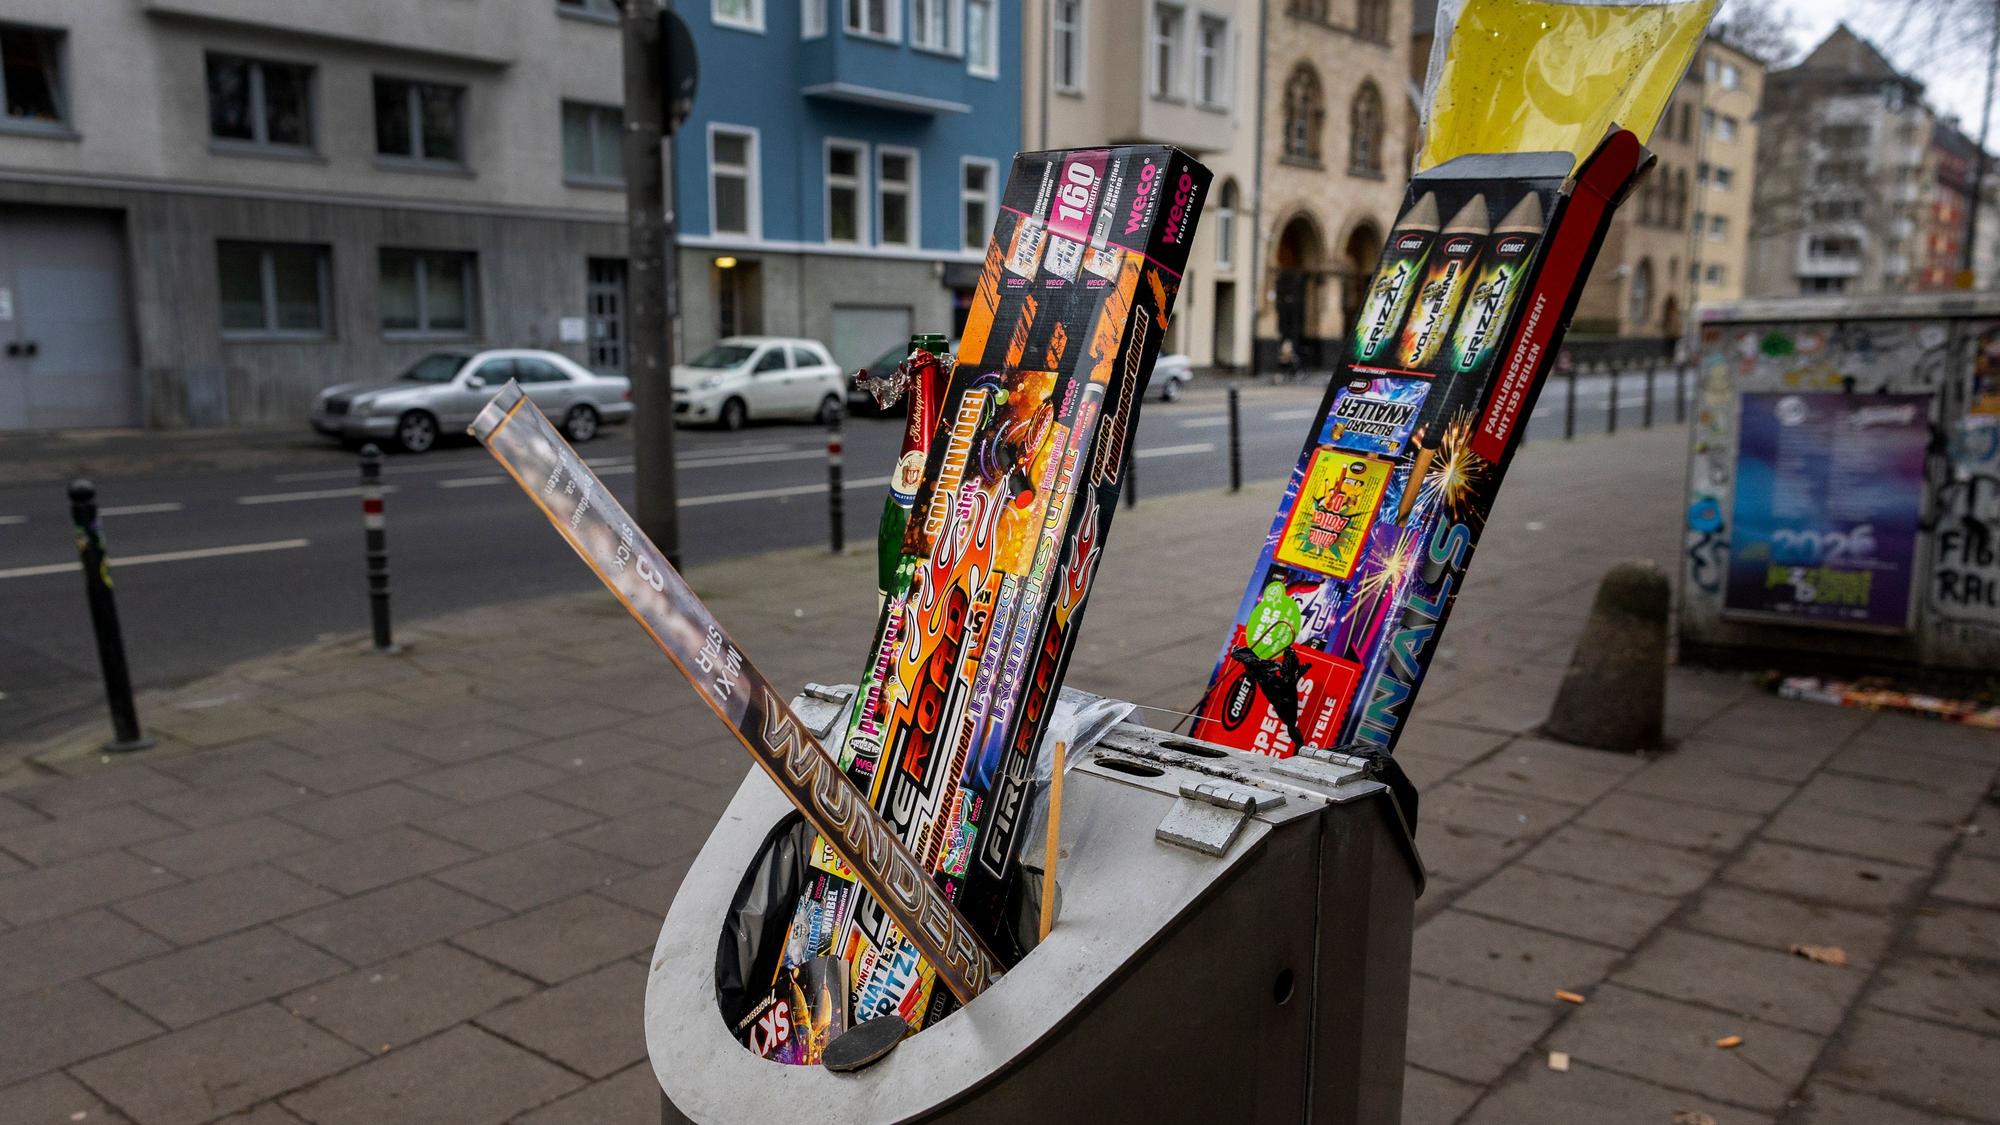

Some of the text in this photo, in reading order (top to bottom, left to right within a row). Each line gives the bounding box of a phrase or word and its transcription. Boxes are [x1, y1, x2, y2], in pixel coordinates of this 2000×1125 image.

[1058, 162, 1096, 222] 160
[1086, 176, 1101, 215] EINZELTEILE
[1100, 209, 1113, 219] 7
[1141, 167, 1163, 229] feuerwerk
[1176, 184, 1198, 245] feuerwerk
[1400, 240, 1422, 250] COMET
[1448, 243, 1471, 253] COMET
[1500, 242, 1525, 253] COMET
[1364, 264, 1408, 356] GRIZZLY
[1410, 262, 1459, 363] WOLVERINE
[1462, 269, 1507, 368] GRIZZLY
[1485, 293, 1548, 434] FAMILIENSORTIMENT
[911, 374, 922, 444] Rotkäppchen
[1058, 377, 1078, 419] weco
[1104, 304, 1150, 485] Familiensortiment
[1338, 398, 1414, 424] KNALLER
[1495, 343, 1541, 441] MIT 139 TEILEN
[1091, 415, 1111, 487] rasantes
[1345, 420, 1394, 437] BLIZZARD
[926, 391, 987, 535] SONNENVOGEL
[1773, 525, 1876, 563] 2026
[635, 554, 665, 592] 3
[694, 625, 723, 674] STAR
[713, 645, 743, 701] MAXI
[903, 590, 967, 782] ROAD
[1230, 677, 1251, 718] COMET
[989, 621, 1061, 864] FIRE ROAD
[1315, 697, 1336, 736] TEILE
[920, 717, 975, 876] amiliensortiment
[808, 907, 822, 954] FUNKEN
[822, 889, 839, 935] WIRBEL
